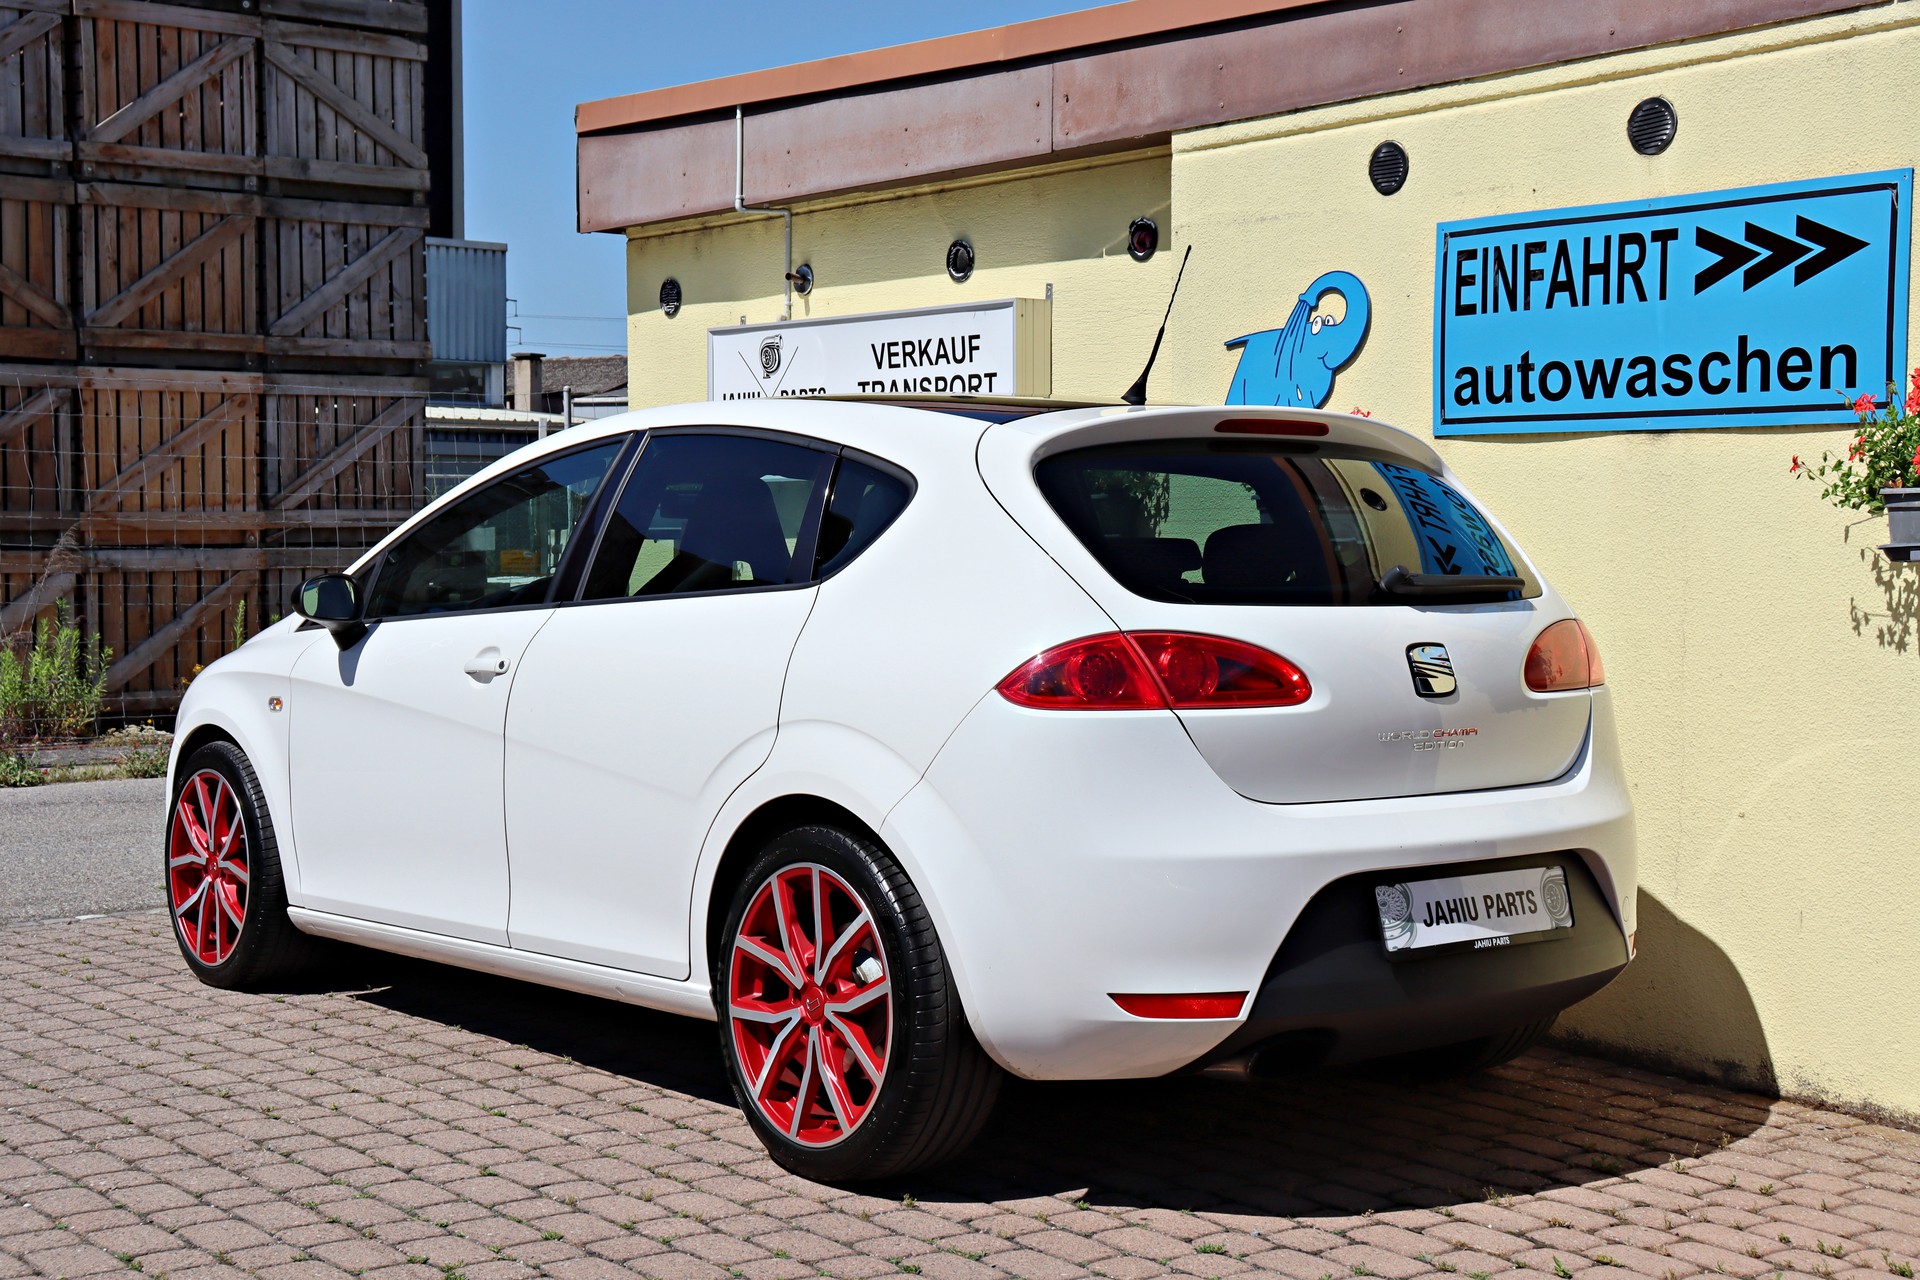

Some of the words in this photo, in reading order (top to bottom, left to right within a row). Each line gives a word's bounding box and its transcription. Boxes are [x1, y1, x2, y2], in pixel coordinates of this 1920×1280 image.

[1455, 228, 1679, 316] EINFAHRT
[871, 334, 981, 370] VERKAUF
[1454, 334, 1857, 406] autowaschen
[1378, 730, 1431, 742] WORLD
[1433, 727, 1478, 738] CHAMPI
[1413, 740, 1465, 752] EDITION
[1423, 896, 1479, 928] JAHIU
[1483, 890, 1538, 919] PARTS
[1474, 939, 1492, 949] JAHIU
[1492, 936, 1511, 946] PARTS
